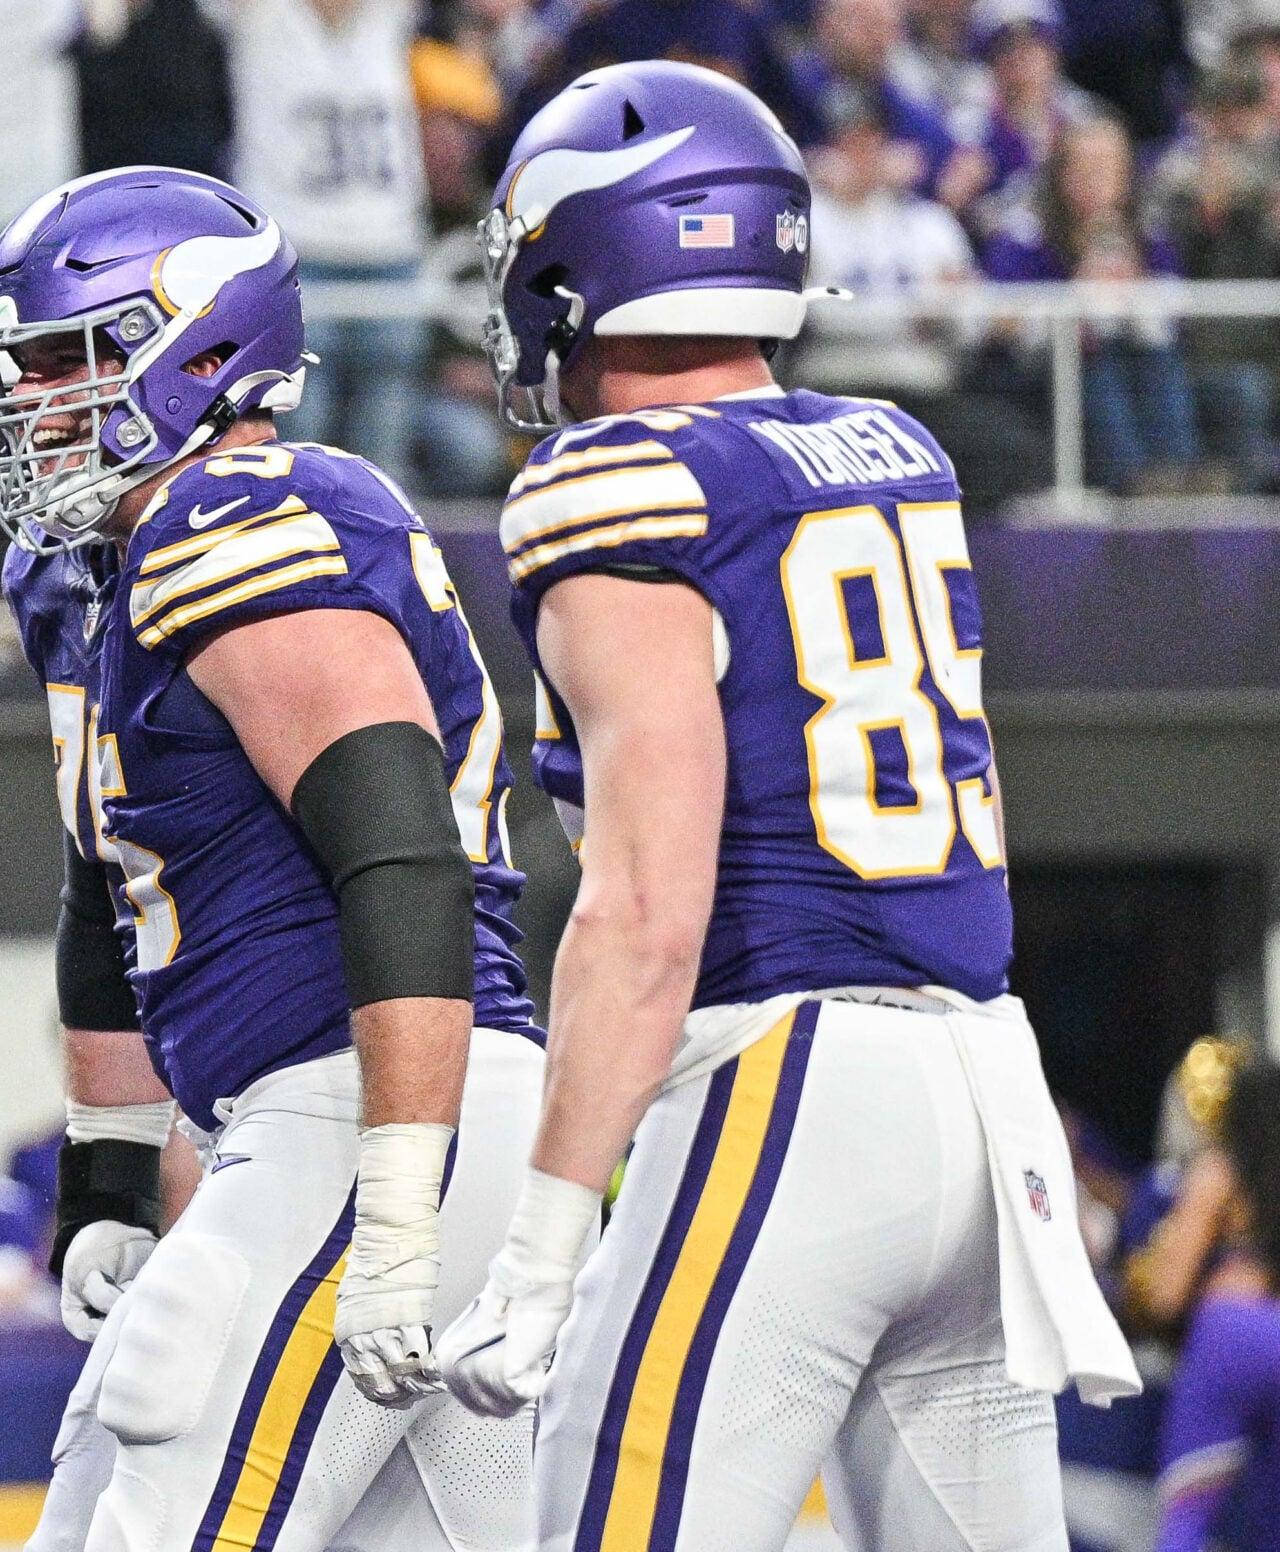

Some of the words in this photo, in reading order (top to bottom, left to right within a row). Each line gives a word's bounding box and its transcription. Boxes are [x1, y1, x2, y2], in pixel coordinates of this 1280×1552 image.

[748, 410, 941, 488] YUROSEK
[780, 501, 1003, 881] 85
[1027, 1190, 1050, 1216] NFL
